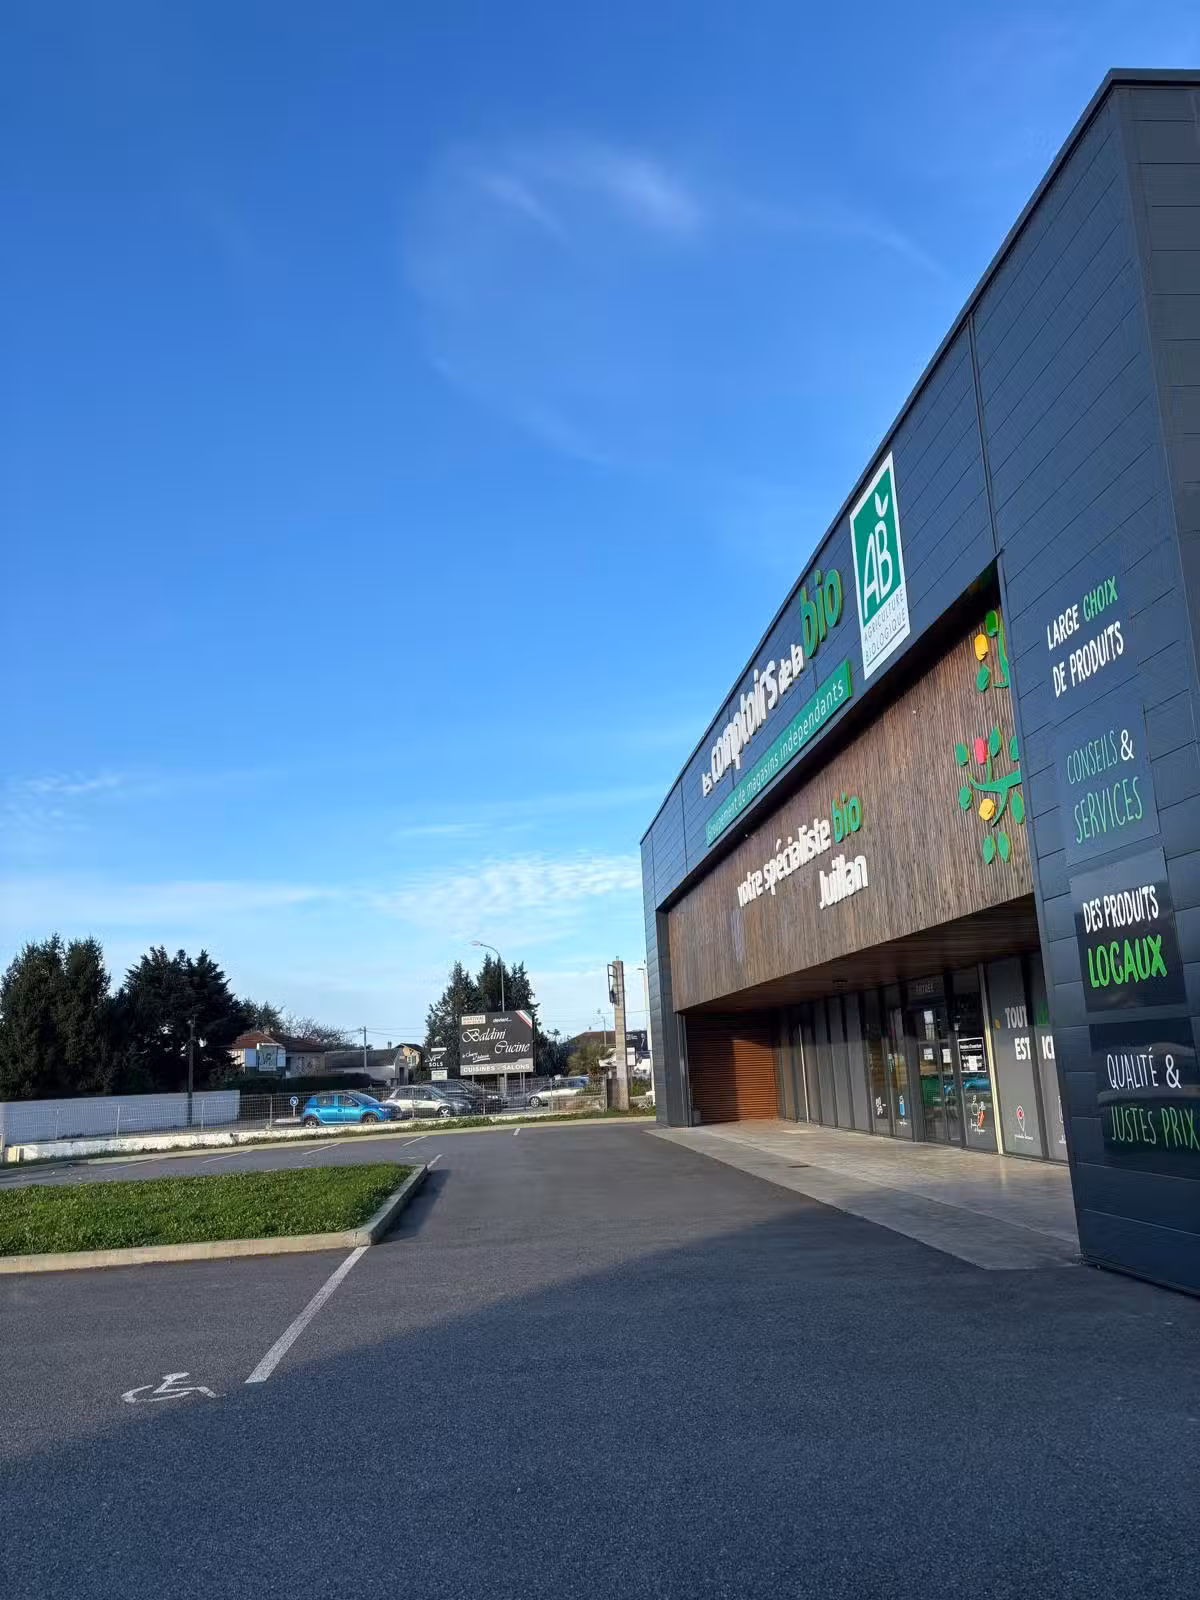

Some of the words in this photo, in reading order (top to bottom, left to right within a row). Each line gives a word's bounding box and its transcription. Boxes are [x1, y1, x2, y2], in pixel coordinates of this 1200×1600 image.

[863, 519, 893, 619] AB
[864, 589, 904, 643] AGRICULTURE
[865, 608, 906, 662] BIOLOGIQUE
[1047, 603, 1080, 651] LARGE
[1083, 575, 1119, 622] CHOIX
[711, 660, 778, 784] comptoirs
[801, 568, 842, 660] bio
[1052, 665, 1067, 698] DE
[1069, 621, 1124, 688] PRODUITS
[738, 788, 746, 804] de
[746, 752, 779, 791] magasins
[780, 679, 844, 762] indépendants
[1066, 729, 1118, 785] CONSEILS
[1120, 728, 1135, 761] &
[1073, 776, 1144, 844] SERVICES
[737, 870, 763, 907] votre
[764, 818, 831, 896] spécialiste
[832, 791, 863, 844] bio
[819, 854, 869, 910] Juillan
[1082, 898, 1103, 934] DES
[1103, 885, 1159, 929] PRODUITS
[1087, 934, 1168, 988] LOCAUX
[461, 1028, 507, 1043] Baldini
[494, 1040, 530, 1054] Cucine
[1014, 1036, 1031, 1060] EST
[463, 1064, 495, 1073] CUISINES
[503, 1063, 530, 1071] SALONS
[1106, 1047, 1159, 1090] QUALITÉ
[1165, 1054, 1181, 1089] &
[1111, 1105, 1157, 1145] JUSTES
[1160, 1106, 1200, 1151] PRIX
